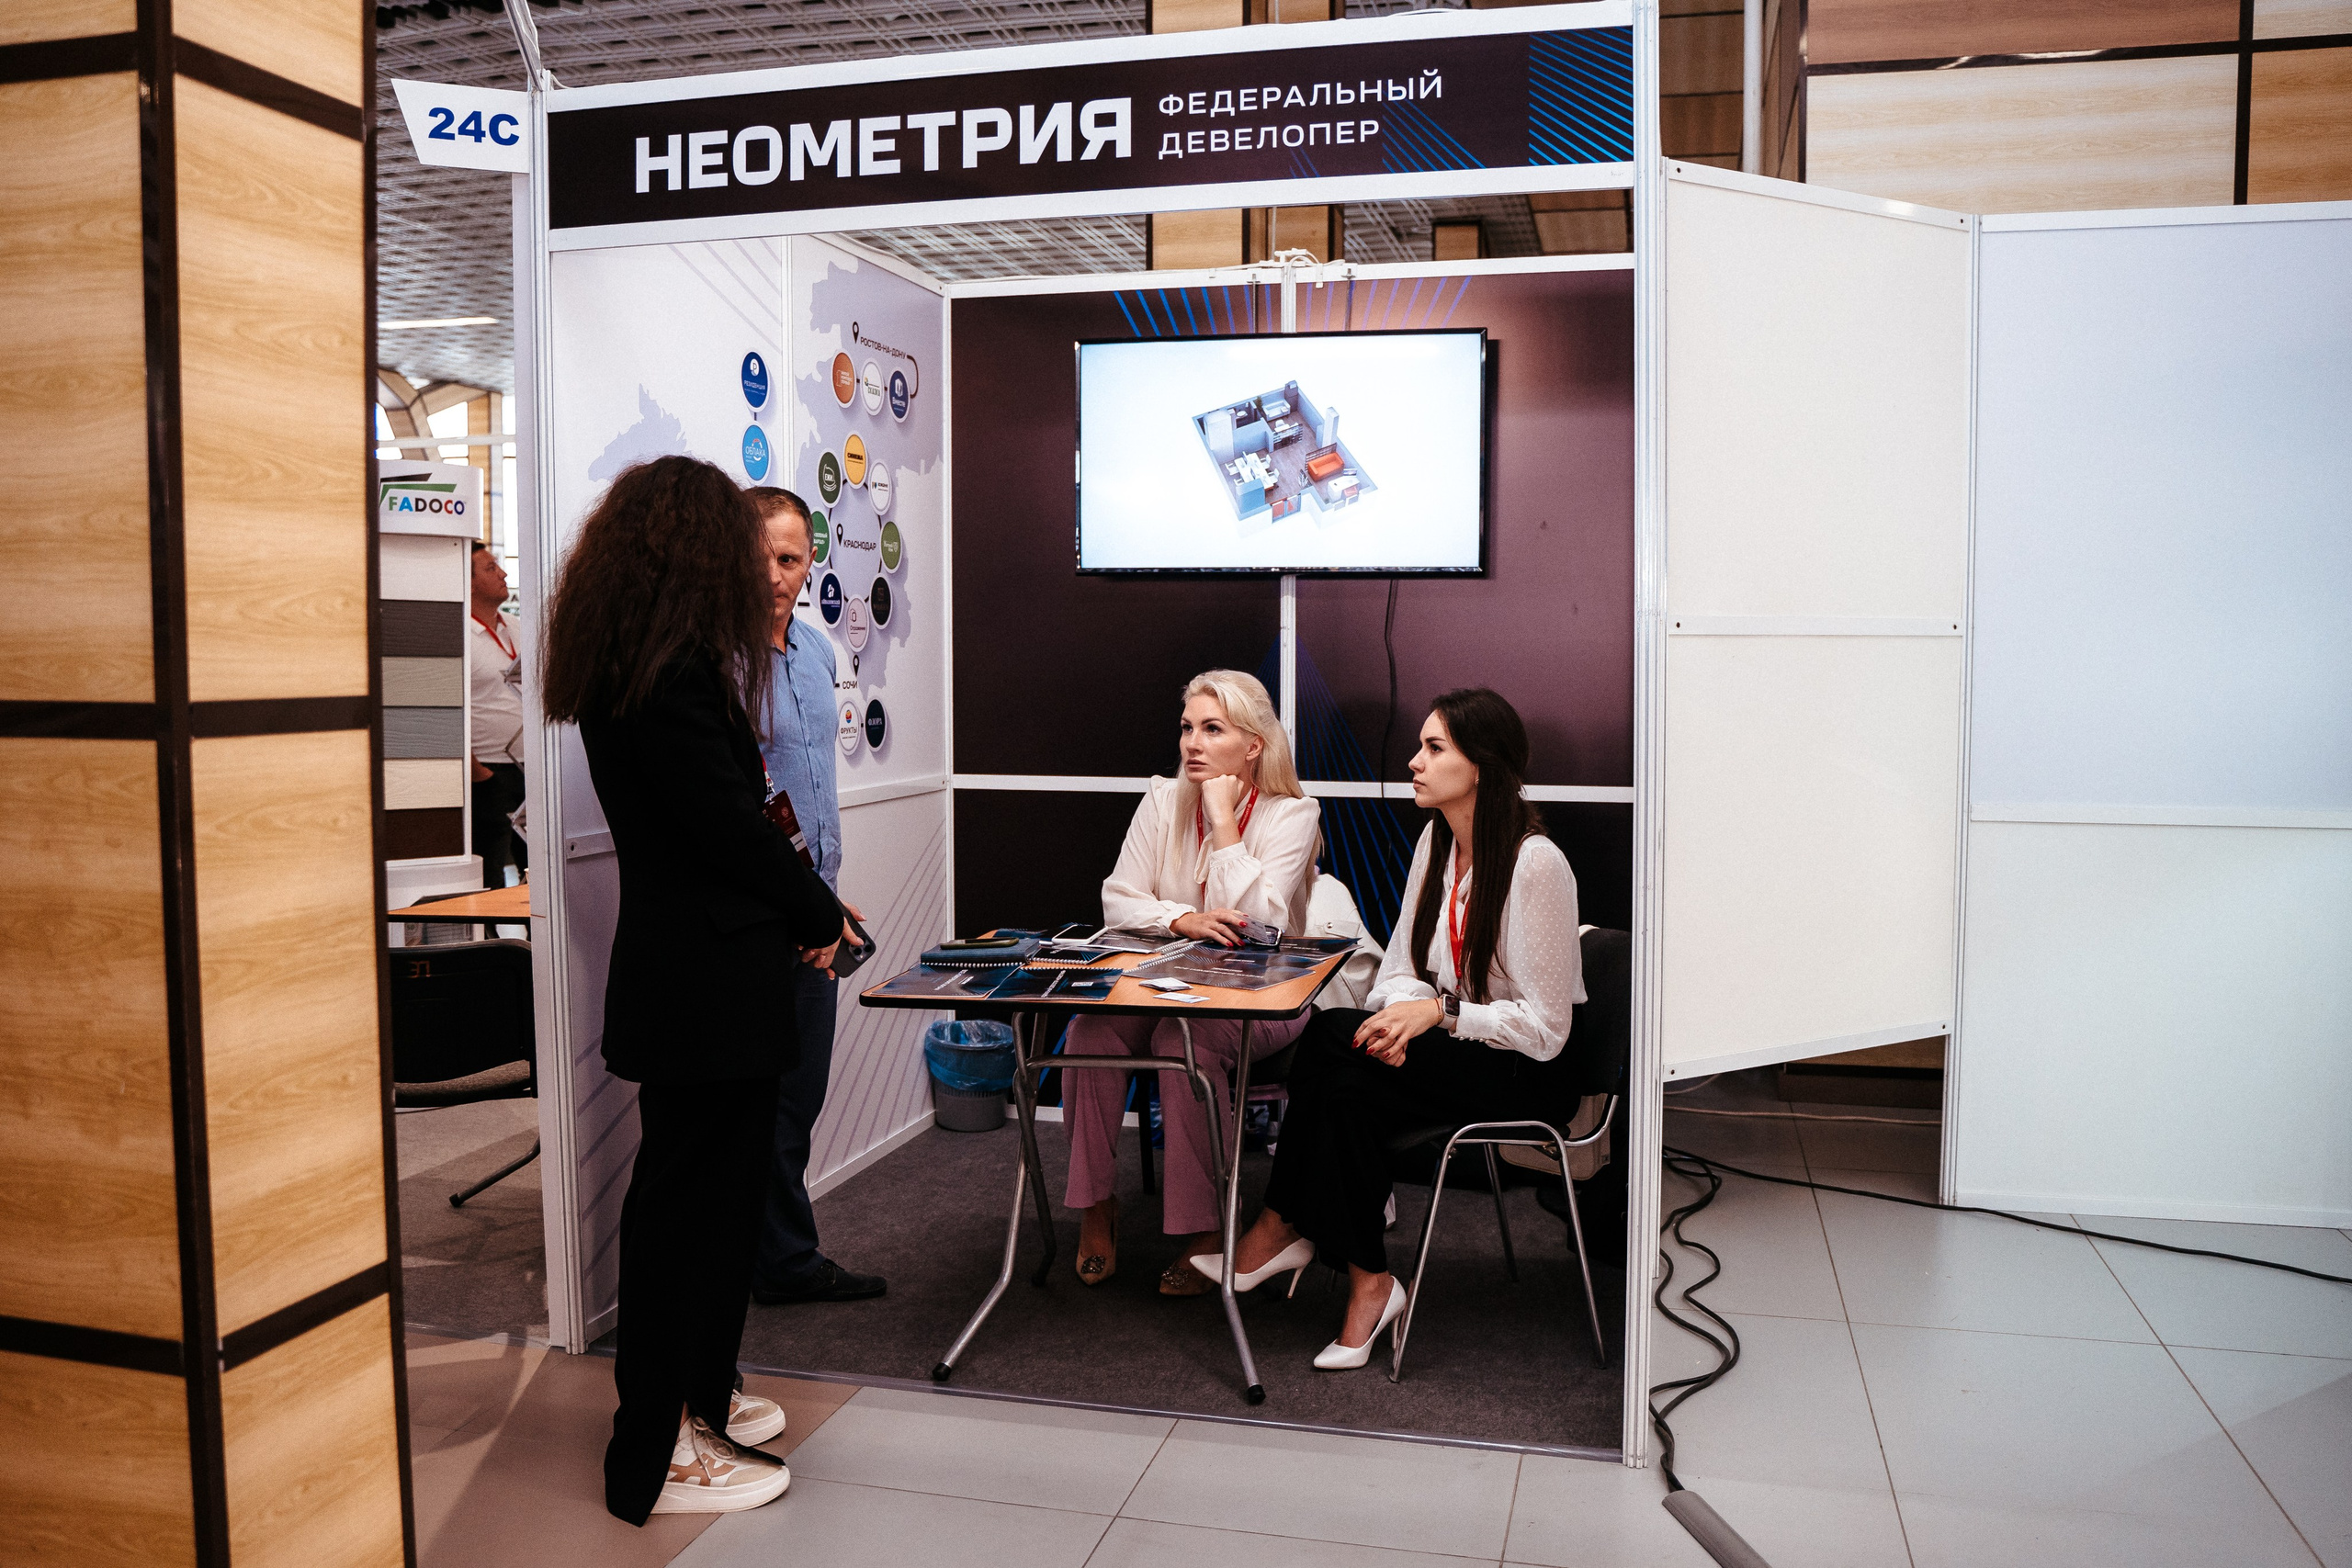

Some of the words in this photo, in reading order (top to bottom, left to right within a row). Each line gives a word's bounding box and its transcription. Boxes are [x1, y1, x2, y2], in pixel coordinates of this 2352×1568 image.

[1159, 69, 1442, 117] ФЕДЕРАЛЬНЫЙ
[635, 96, 1133, 194] НЕОМЕТРИЯ
[1159, 119, 1381, 160] ДЕВЕЛОПЕР
[860, 336, 907, 360] РОСТОВ-НА-ДОНУ
[746, 446, 766, 457] ОБЛАКА
[388, 496, 465, 515] FADOCO
[843, 538, 877, 552] КРАСНОДАР
[842, 681, 858, 690] СОЧИ
